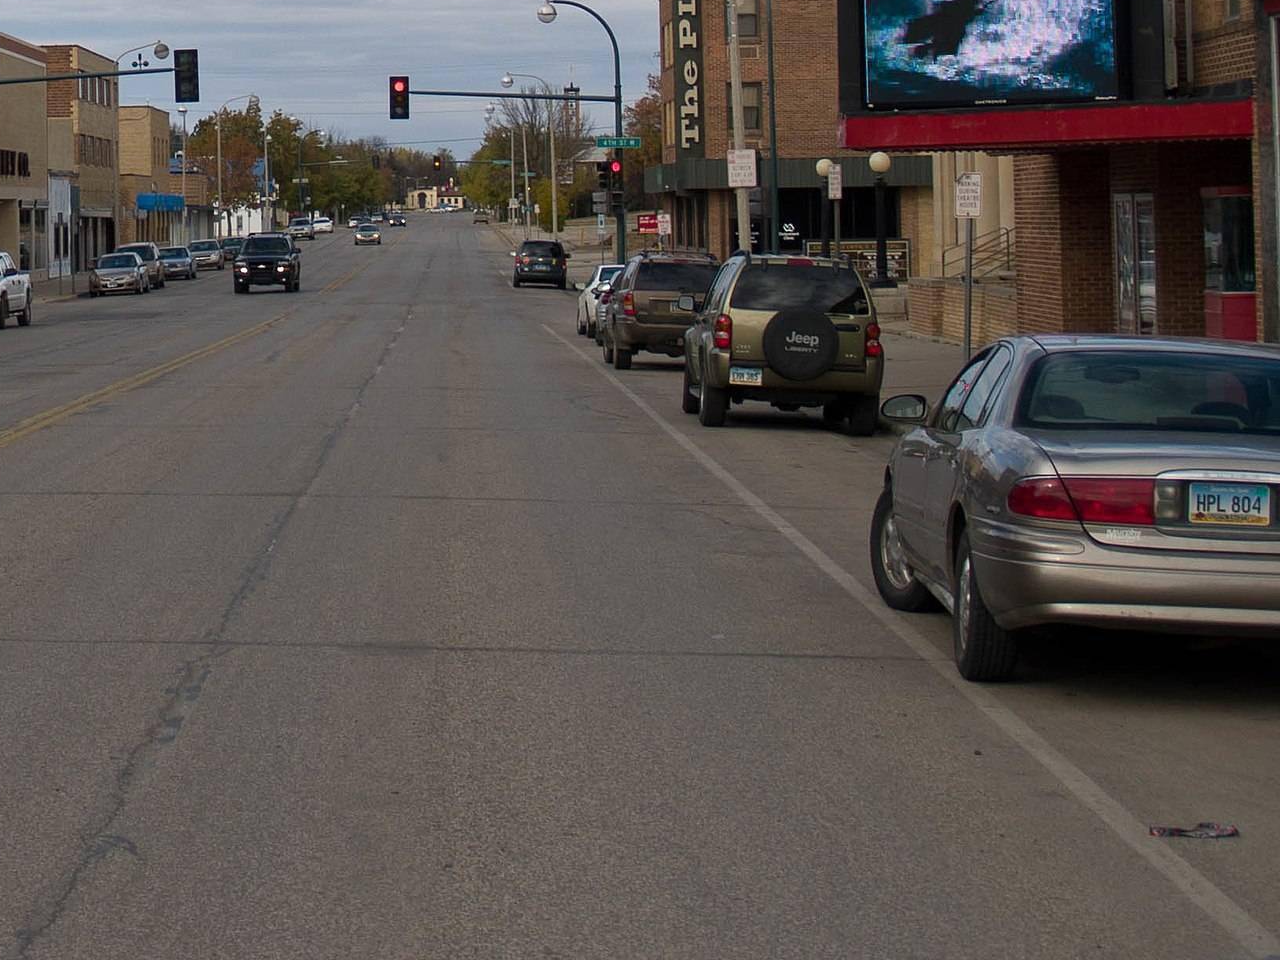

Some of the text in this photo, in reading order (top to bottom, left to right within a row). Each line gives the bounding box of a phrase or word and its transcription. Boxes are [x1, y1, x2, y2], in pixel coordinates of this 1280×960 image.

[680, 59, 700, 149] The
[785, 330, 819, 347] Jeep
[1196, 493, 1262, 515] HPL 804
